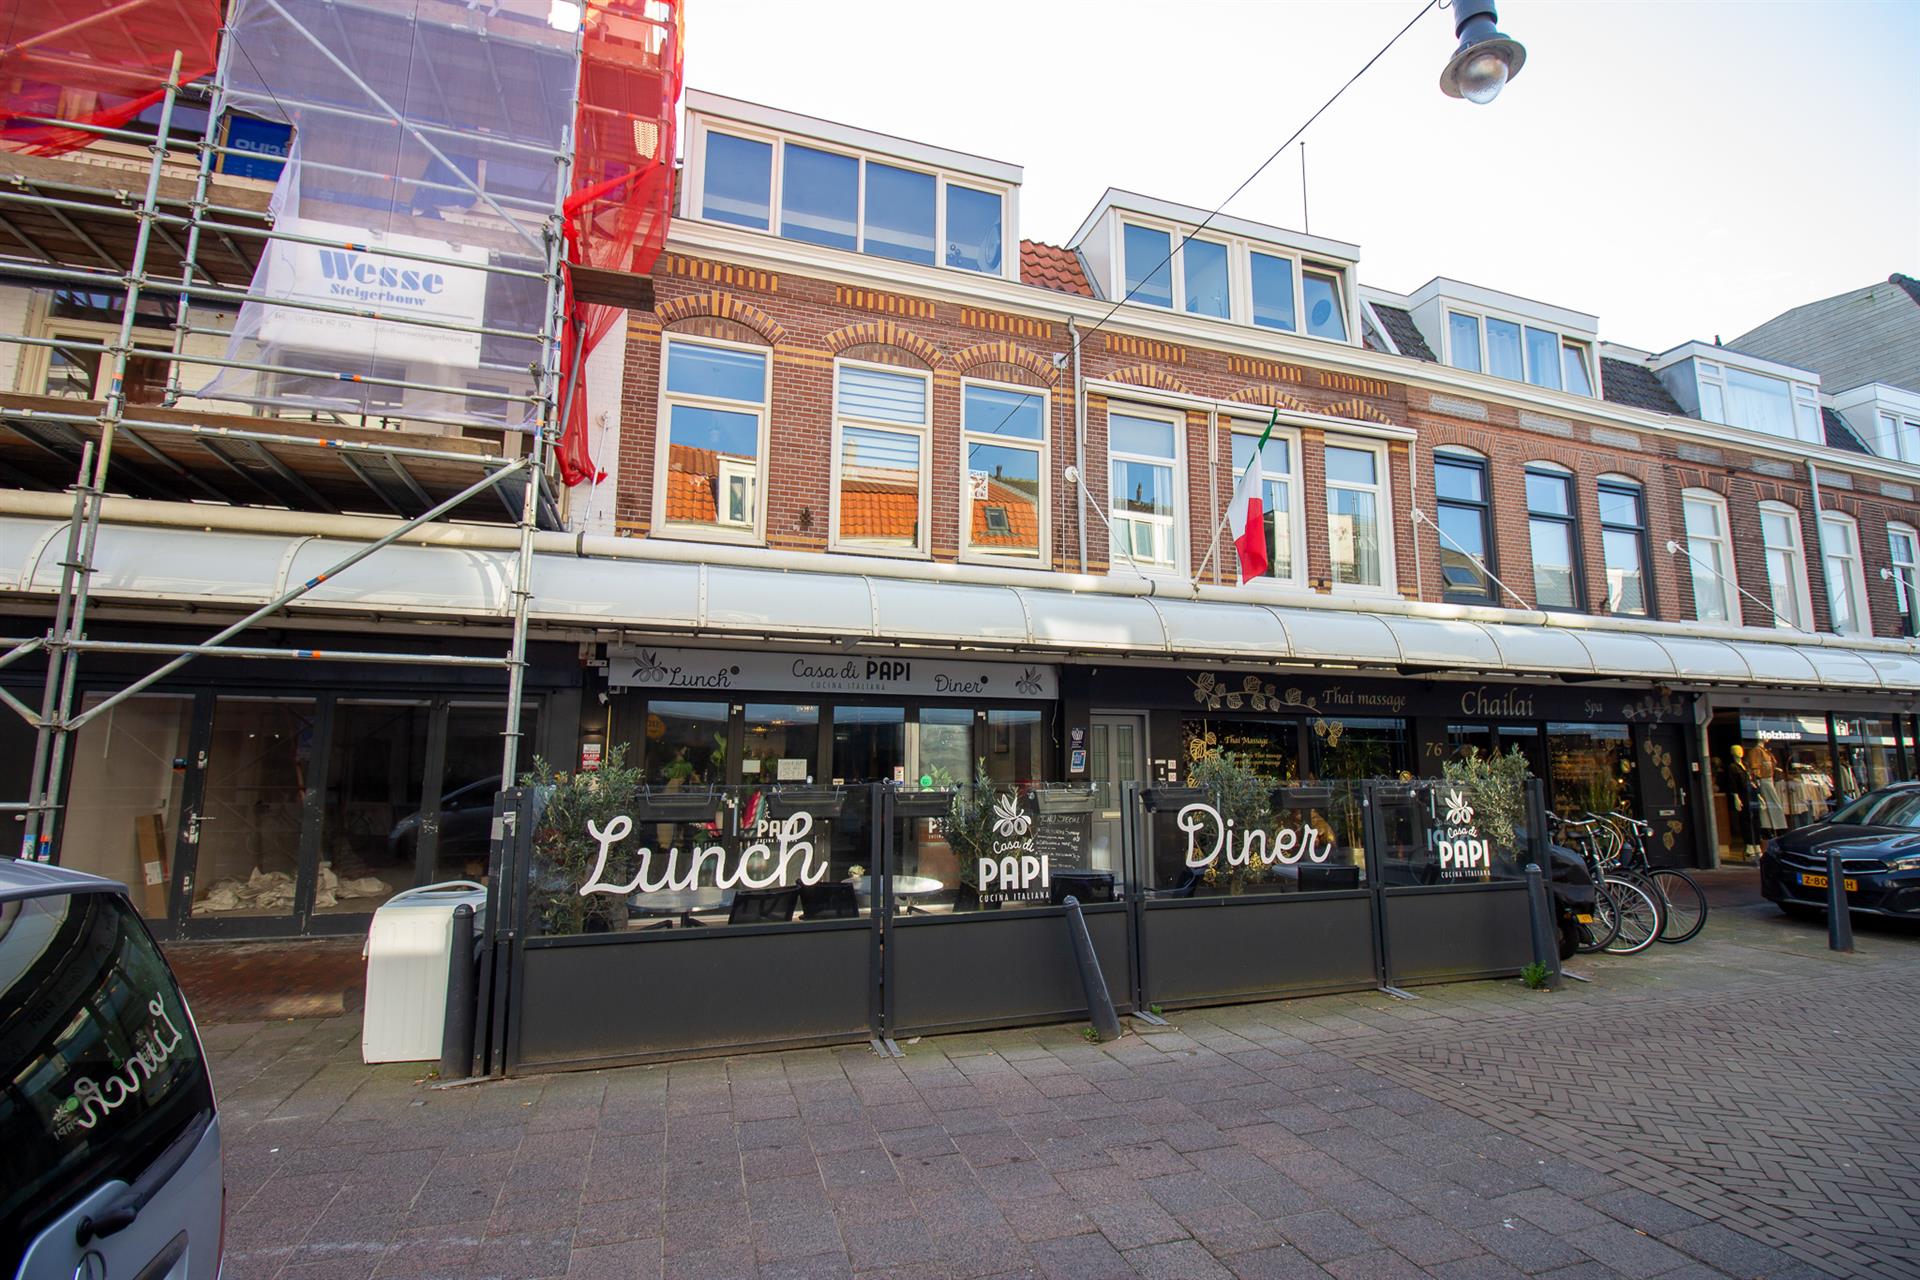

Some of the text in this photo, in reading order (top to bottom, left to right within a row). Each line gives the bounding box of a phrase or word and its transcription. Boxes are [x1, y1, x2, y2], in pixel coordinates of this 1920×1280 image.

[319, 250, 444, 295] Wesse
[330, 283, 426, 306] Steigerbouw
[668, 666, 731, 688] Lunch
[792, 659, 911, 682] Casa di PAPI
[811, 681, 886, 691] CUCINA ITALIANA
[934, 674, 983, 694] Diner
[1322, 687, 1407, 713] Thai massage
[1461, 686, 1534, 717] Chailai
[1584, 699, 1604, 719] Spa
[1758, 730, 1802, 740] Holzhaus
[1425, 742, 1443, 758] 76
[1177, 803, 1332, 868] Diner
[1447, 826, 1478, 839] Casa di
[579, 811, 829, 896] Lunch
[993, 838, 1035, 854] Casa di
[1439, 839, 1491, 869] PAPI
[979, 855, 1049, 891] PAPI
[1441, 869, 1492, 879] CUCINA ITALIANA
[979, 891, 1050, 903] CUCINA ITALIANA
